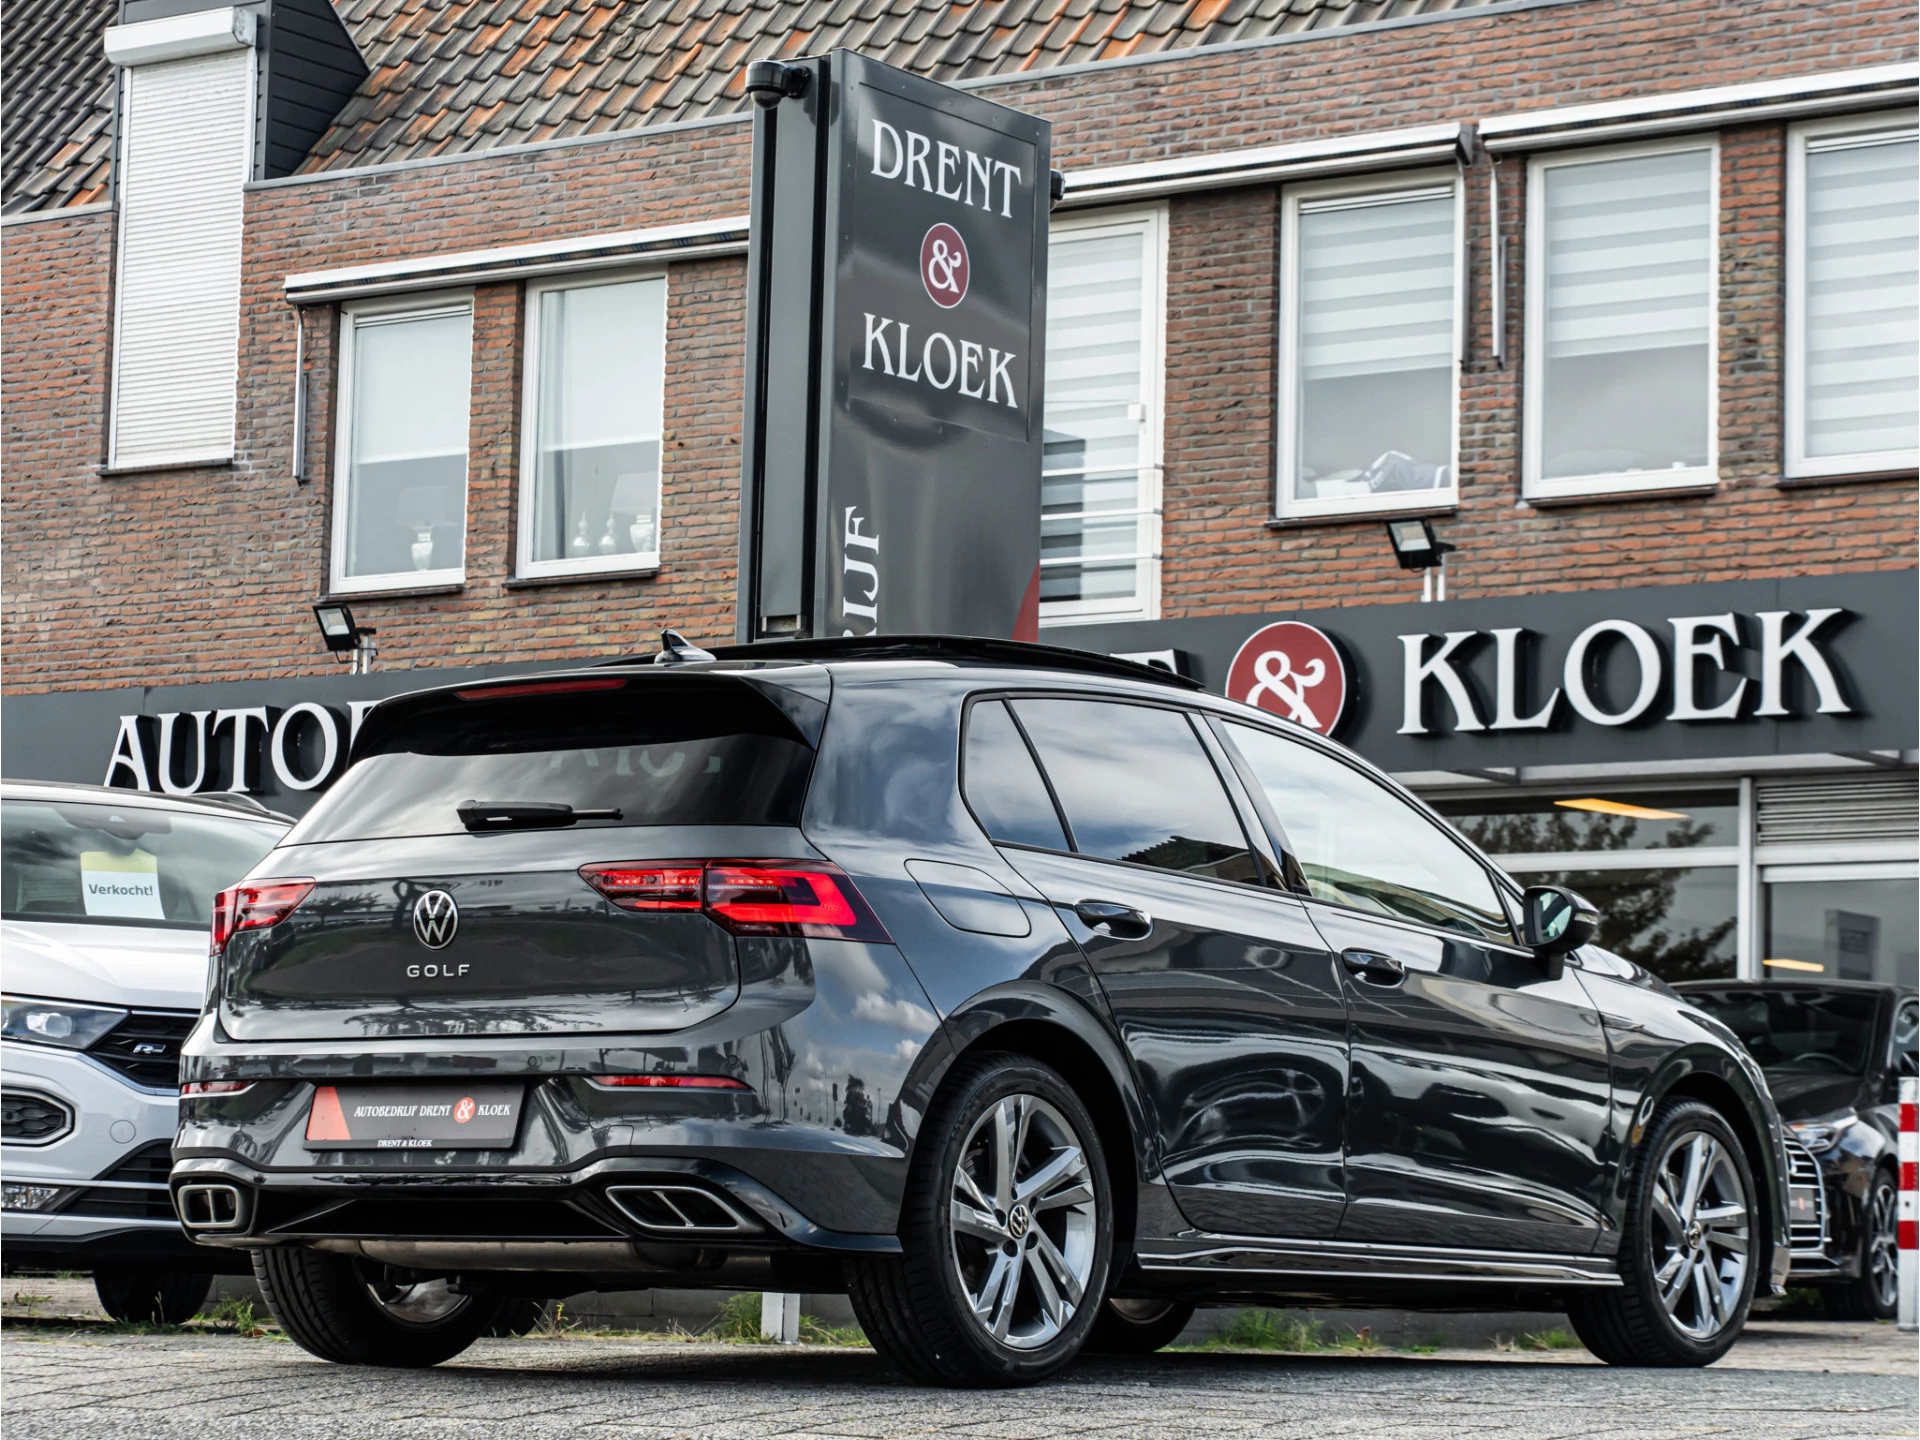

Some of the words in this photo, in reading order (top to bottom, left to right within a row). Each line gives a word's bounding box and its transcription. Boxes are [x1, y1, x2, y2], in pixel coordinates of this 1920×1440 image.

[871, 119, 1022, 218] DRENT
[928, 239, 962, 293] &
[862, 312, 1018, 409] KLOEK
[842, 506, 880, 637] IJF
[1245, 650, 1325, 729] &
[1396, 608, 1852, 735] KLOEK
[88, 883, 154, 896] Verkocht!
[406, 963, 471, 978] GOLF
[354, 1105, 418, 1117] AUTOBEDRIJF
[419, 1105, 452, 1116] DRENT
[457, 1100, 474, 1120] &
[478, 1104, 511, 1116] KLOEK
[377, 1139, 401, 1147] DRENT
[401, 1139, 409, 1147] &
[409, 1139, 433, 1147] KLOEK
